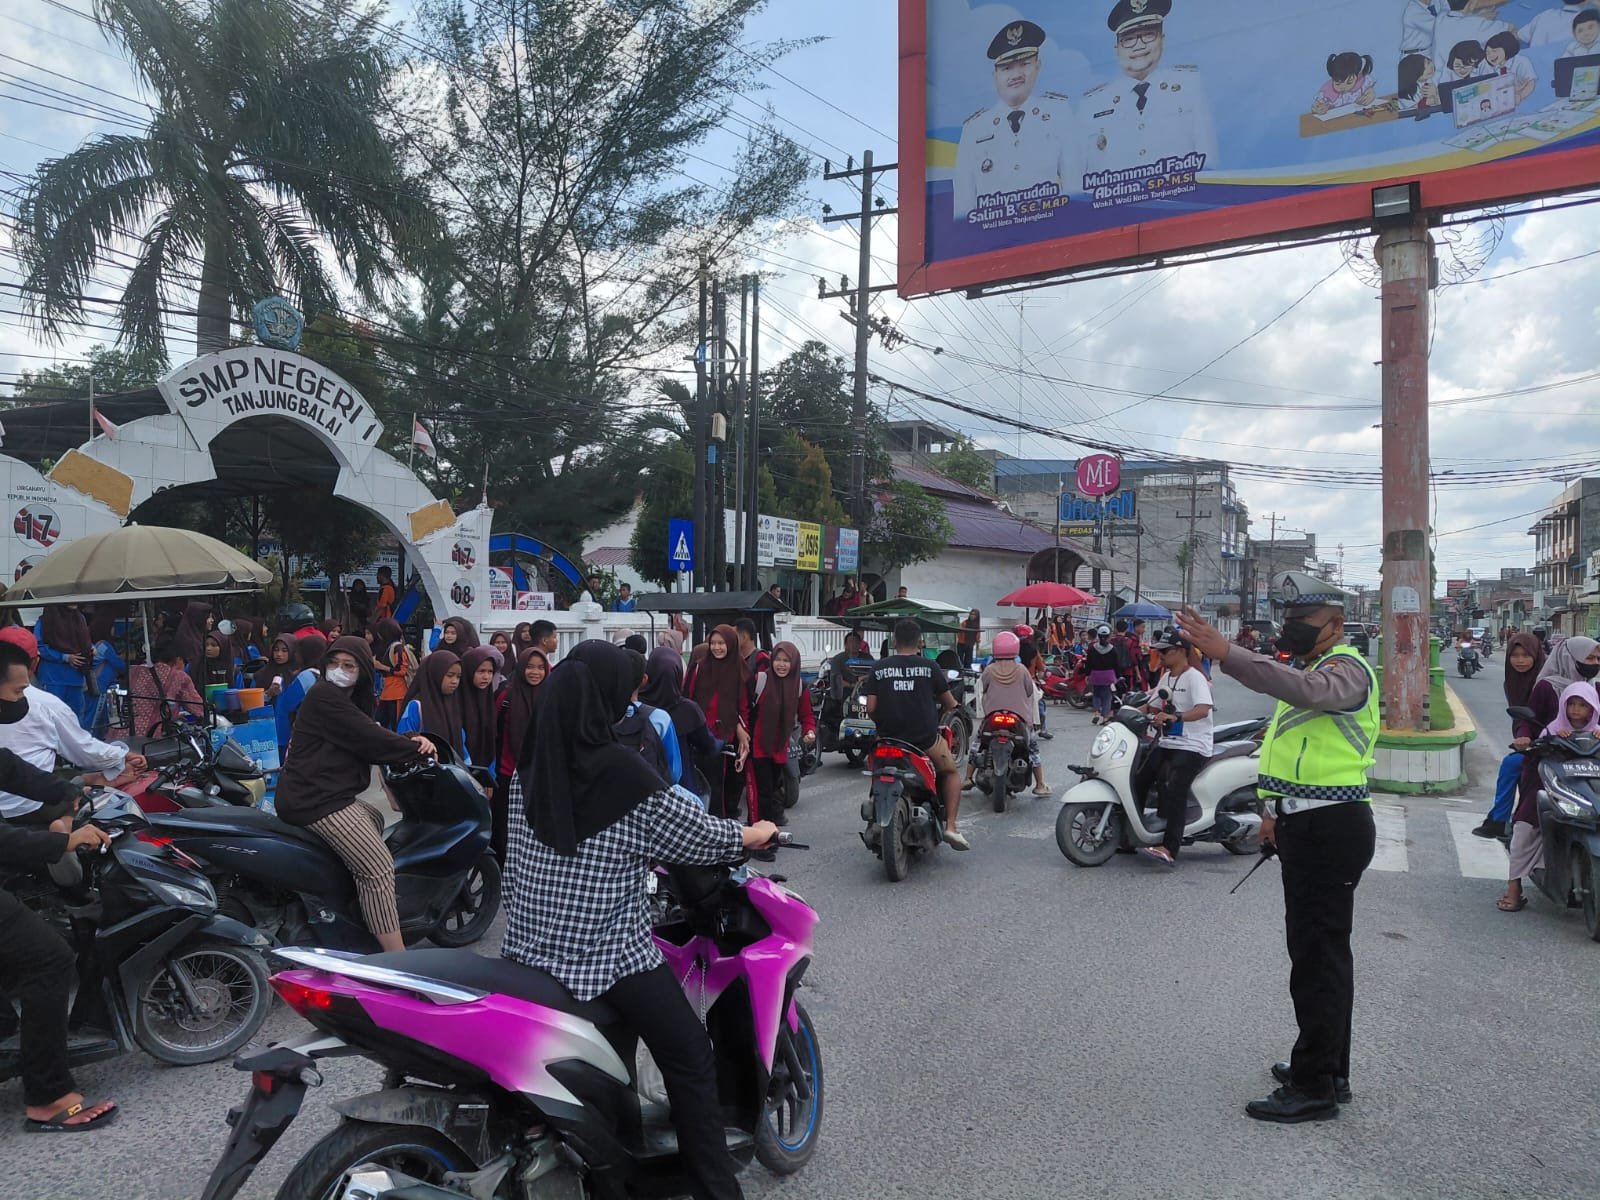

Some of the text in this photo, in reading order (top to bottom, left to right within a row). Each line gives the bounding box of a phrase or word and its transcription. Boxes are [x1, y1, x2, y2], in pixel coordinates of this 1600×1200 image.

[1085, 154, 1205, 188] Muhammad Fadly
[979, 184, 1058, 209] Mahyaruddin
[1092, 184, 1196, 209] Wakil Wali Kota Tanjungbalai
[969, 208, 1003, 224] Salim
[982, 211, 1054, 230] Wali Kota Tanjungbalai
[179, 357, 377, 440] SMP NEGERI 1
[222, 390, 343, 436] TANJUNGBALAI
[1086, 459, 1112, 488] MIE
[21, 513, 53, 541] 17
[1069, 527, 1093, 535] PEDAS
[805, 533, 819, 556] OSIS
[456, 547, 472, 566] 17
[454, 585, 471, 605] 08
[875, 666, 932, 681] SPECIAL EVENTS
[893, 680, 915, 691] CREW
